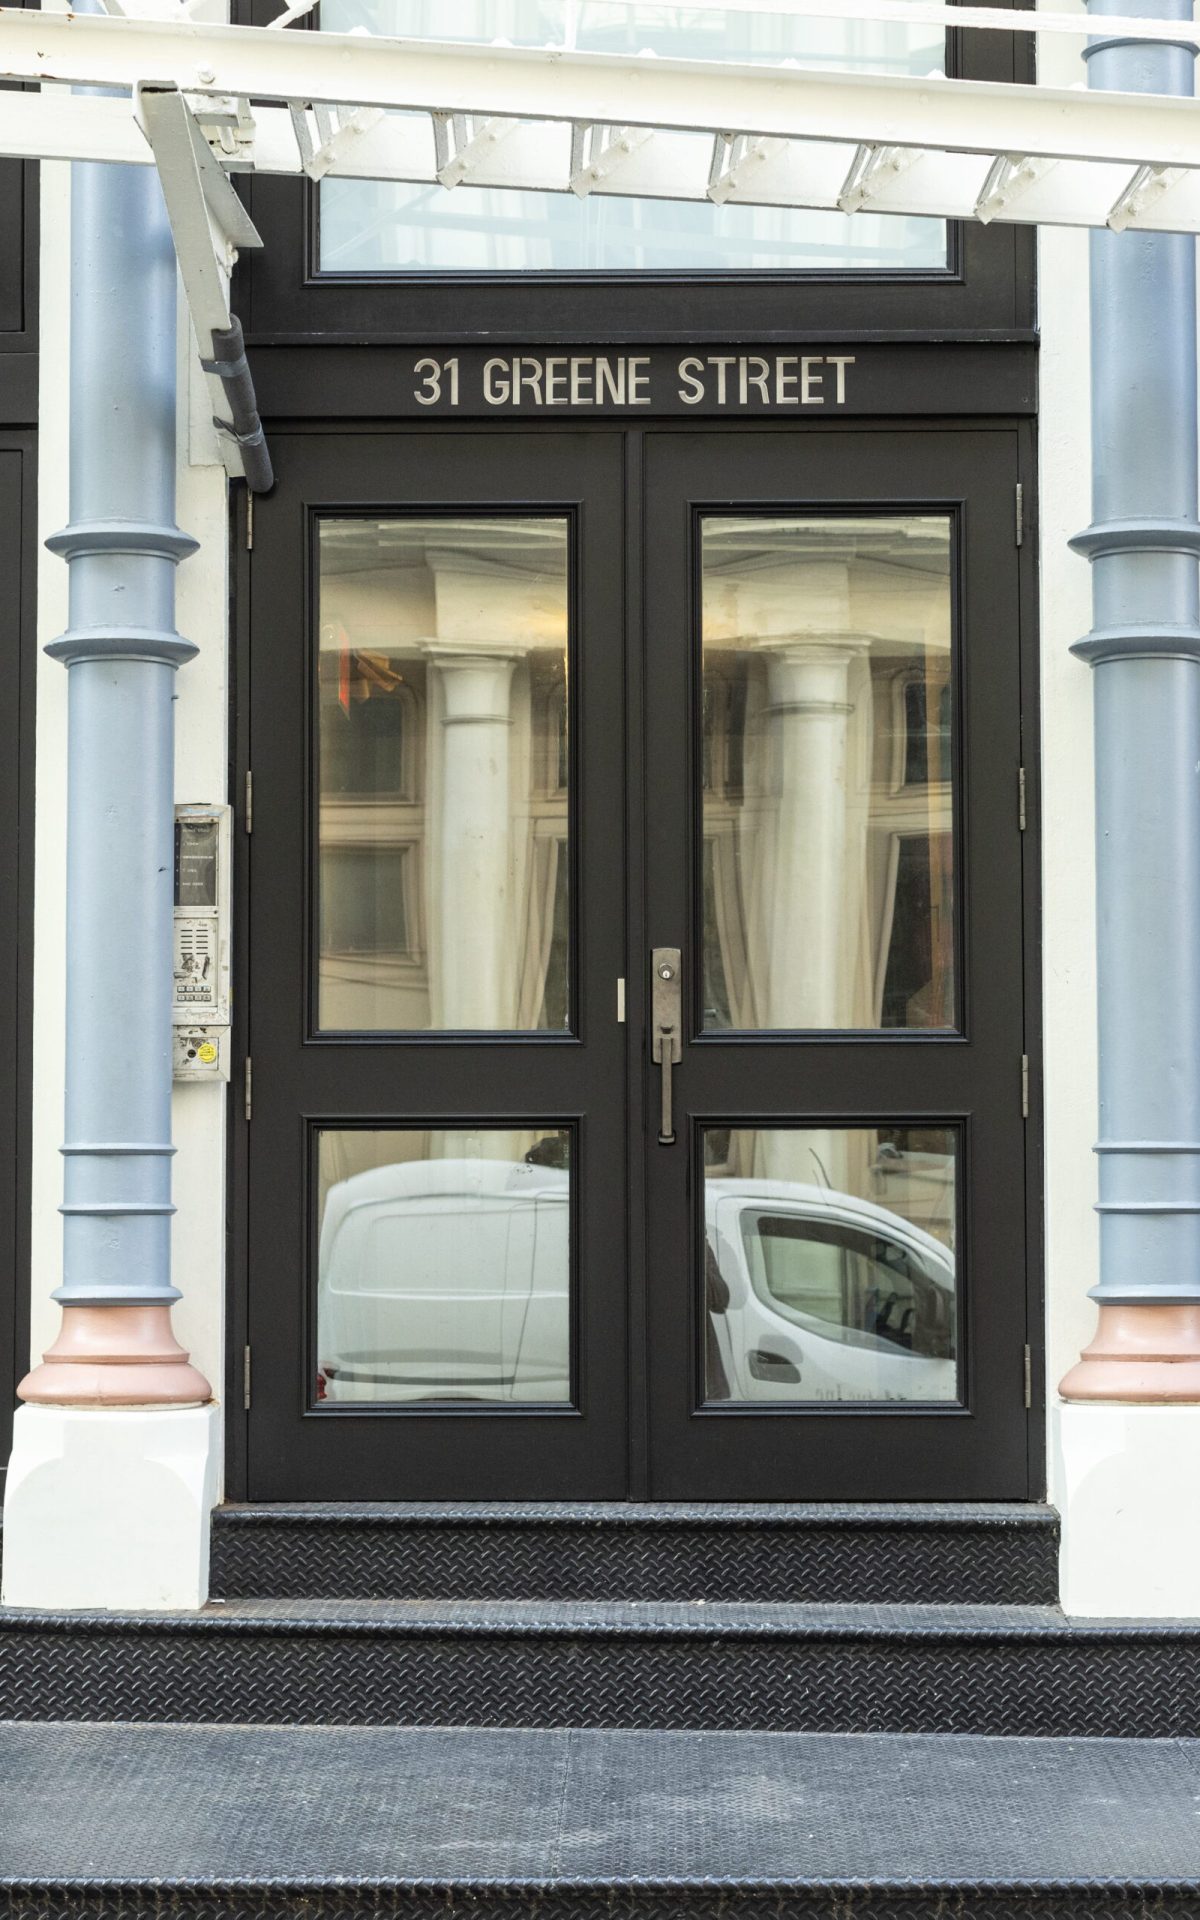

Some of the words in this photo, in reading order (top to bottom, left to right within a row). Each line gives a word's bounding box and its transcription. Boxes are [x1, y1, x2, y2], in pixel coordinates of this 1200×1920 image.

[413, 357, 459, 405] 31
[483, 357, 651, 405] GREENE
[678, 356, 856, 404] STREET
